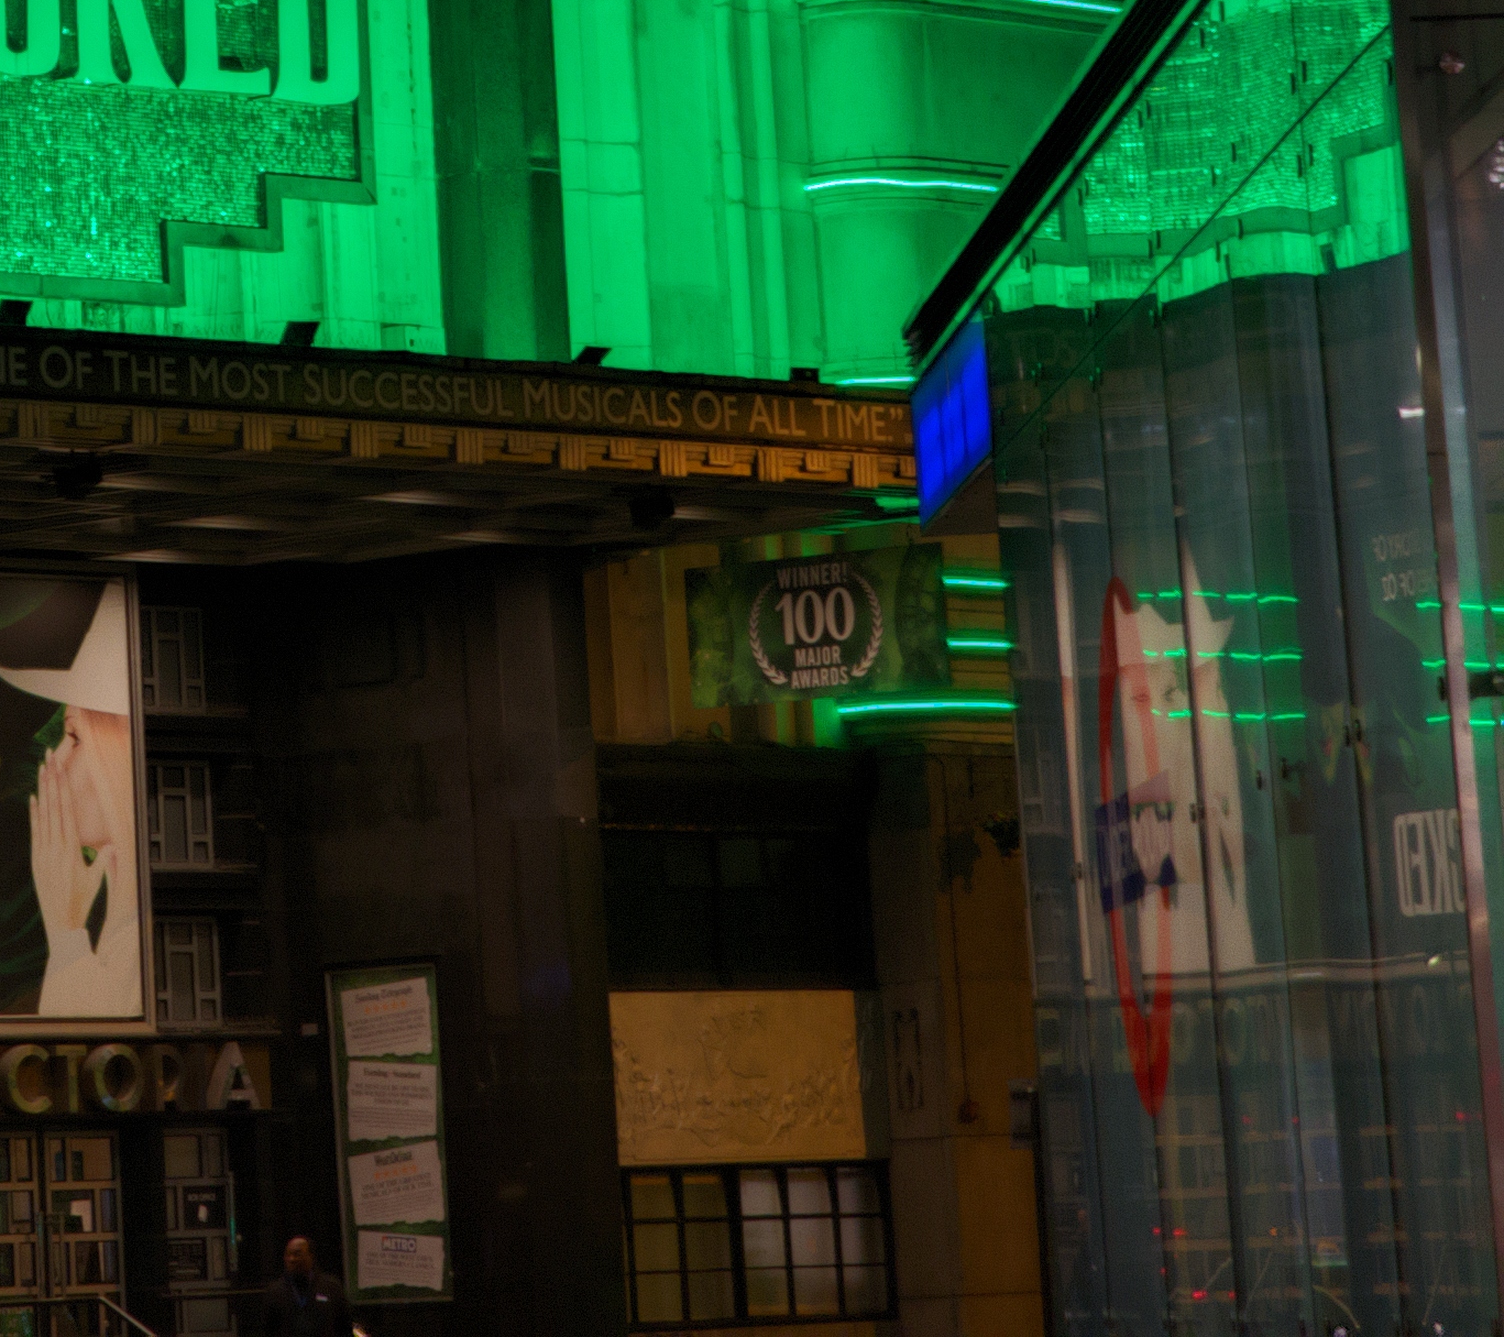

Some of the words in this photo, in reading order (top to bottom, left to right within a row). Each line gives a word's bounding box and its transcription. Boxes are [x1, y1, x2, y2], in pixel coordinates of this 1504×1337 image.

[39, 344, 94, 391] OF
[102, 347, 178, 396] THE
[188, 356, 293, 404] MOST
[303, 363, 514, 421] SUCCESSFUL
[523, 377, 683, 430] MUSICALS
[693, 393, 741, 434] OF
[749, 392, 806, 441] ALL
[777, 562, 848, 590] WINNER!
[774, 586, 856, 646] 100
[794, 645, 842, 668] MAJOR
[790, 666, 849, 690] AWARDS
